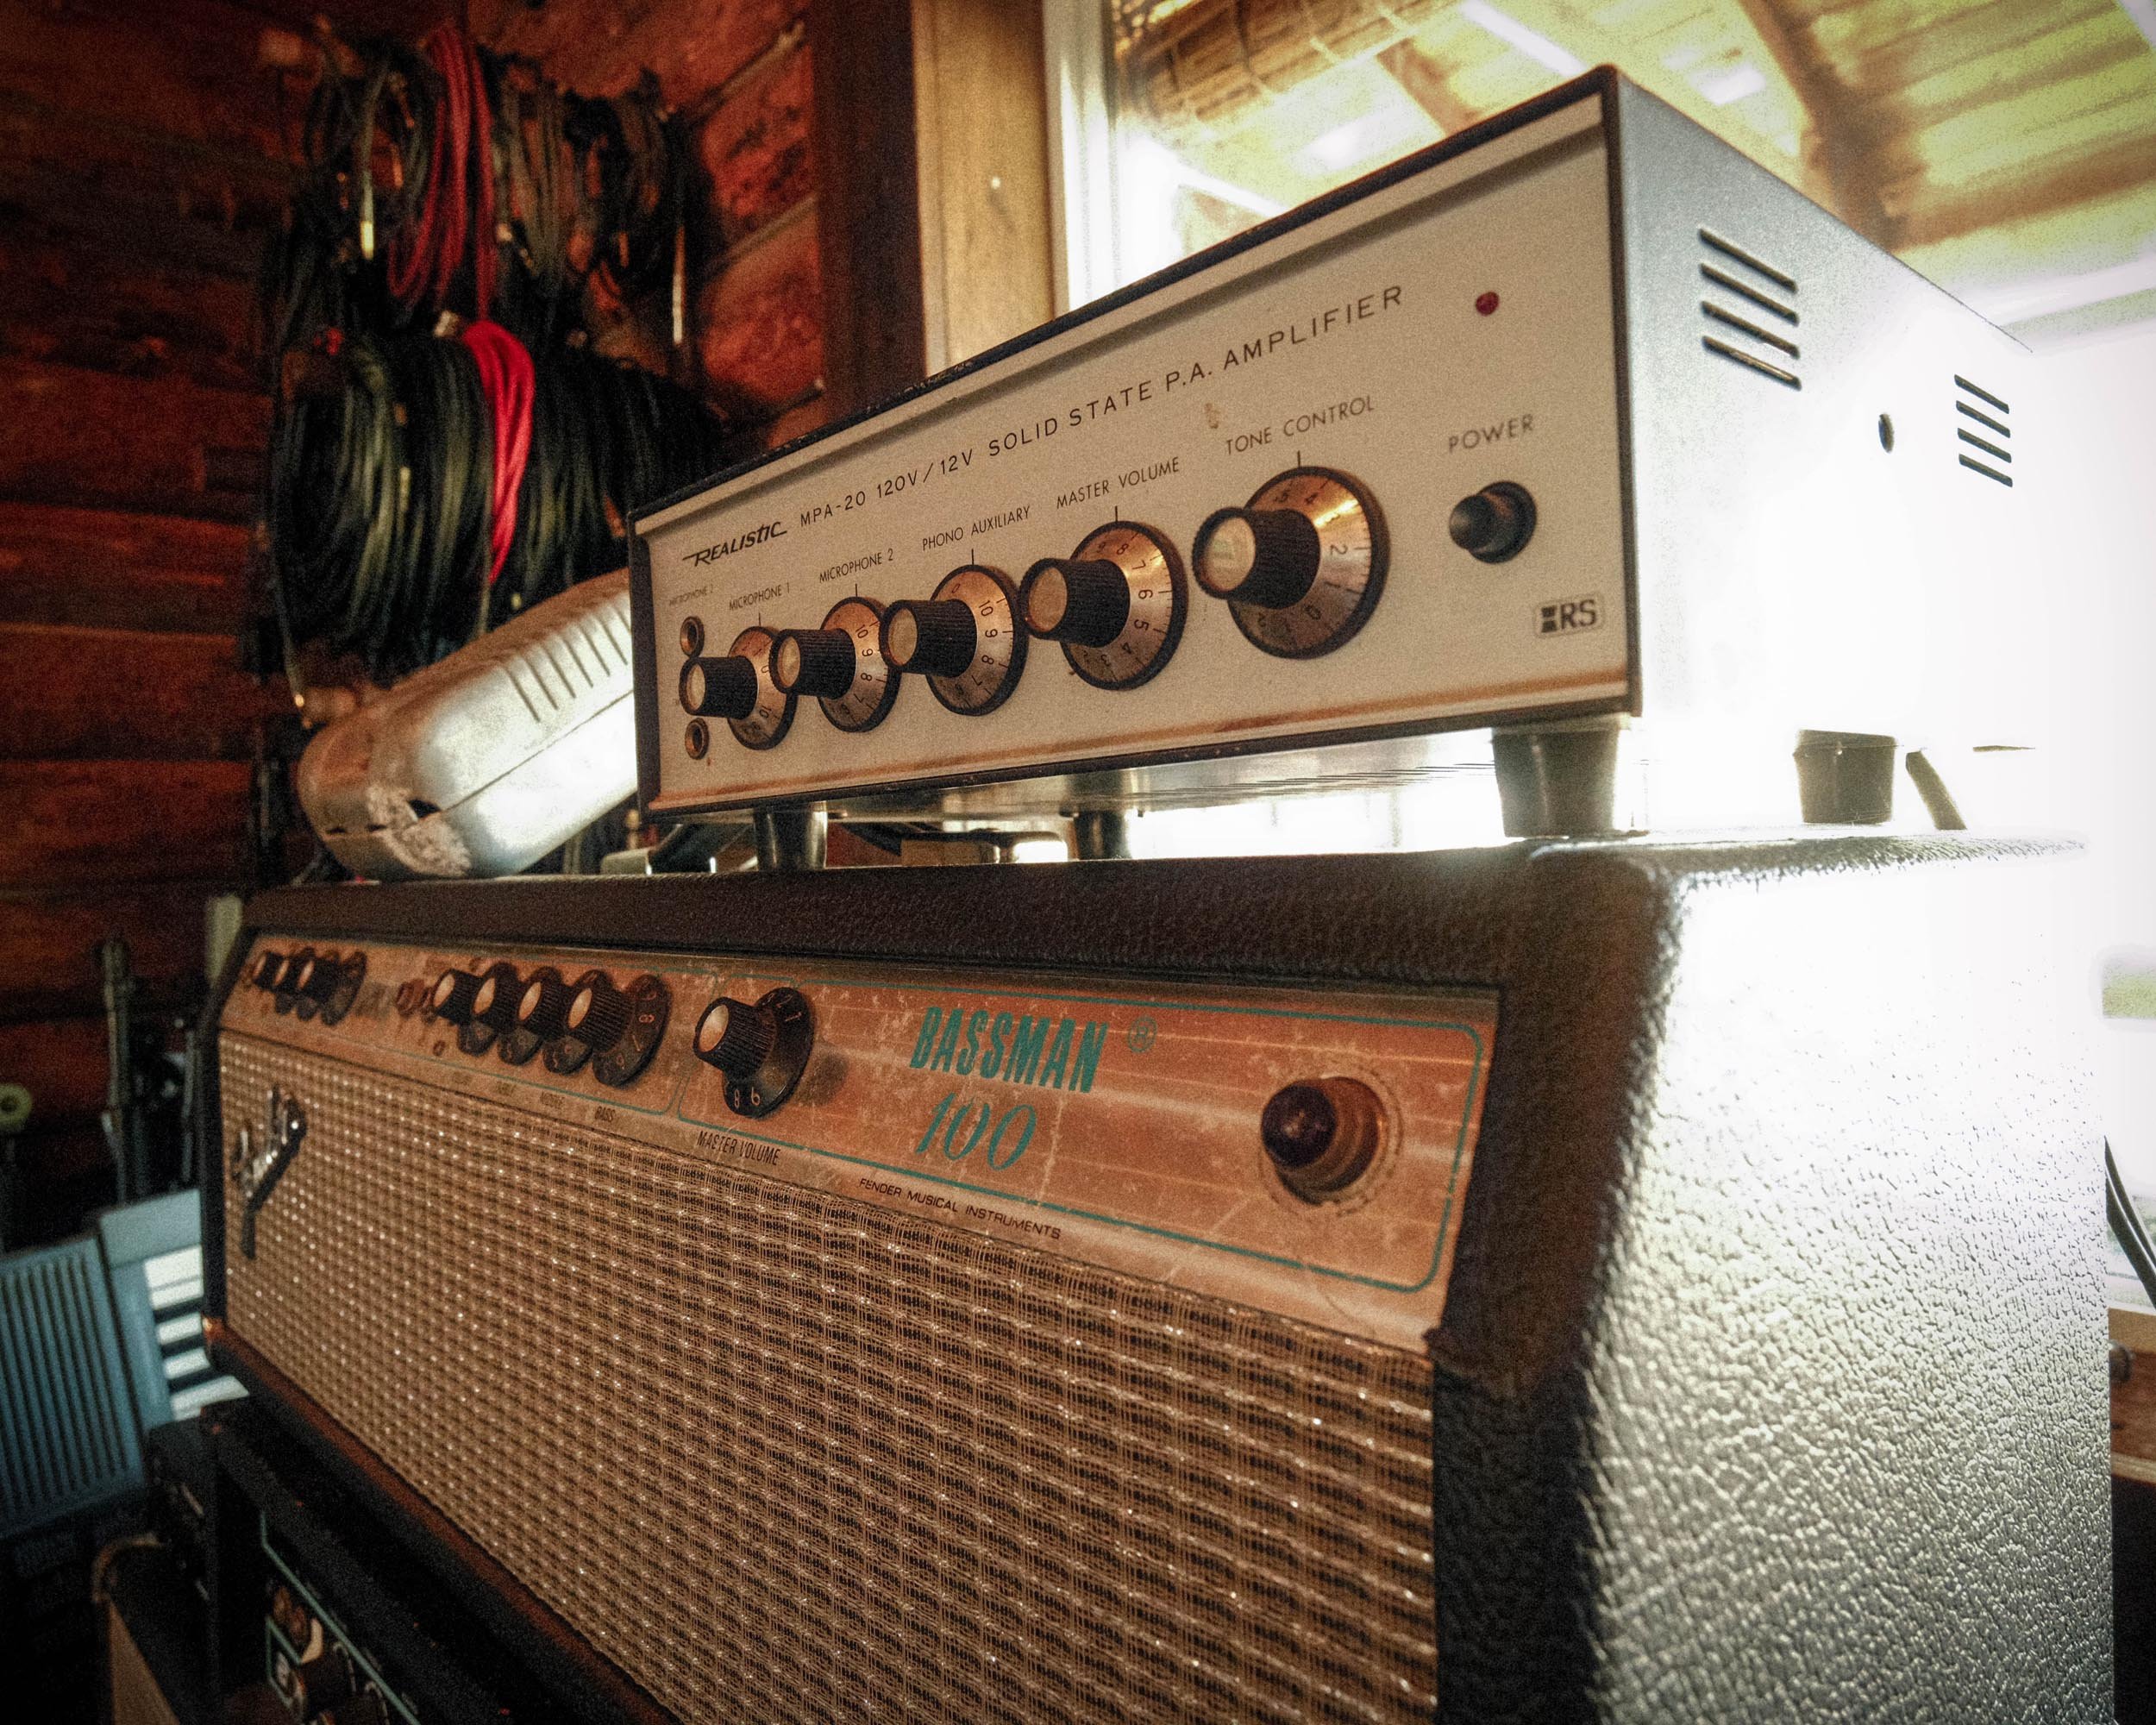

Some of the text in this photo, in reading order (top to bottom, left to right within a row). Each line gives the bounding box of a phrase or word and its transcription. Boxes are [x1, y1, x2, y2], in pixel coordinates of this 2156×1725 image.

[800, 491, 866, 527] MPA-20
[988, 417, 1058, 457] SOLID
[1069, 380, 1152, 427] STATE
[1166, 363, 1213, 392] P.A.
[1224, 285, 1402, 369] AMPLIFIER
[1225, 395, 1375, 455] TONE CONTROL
[1449, 414, 1534, 454] POWER
[1056, 457, 1180, 509] MASTER VOLUME
[923, 505, 1031, 551] PHONO AUXILIARY
[1116, 543, 1129, 556] 8
[1330, 543, 1347, 555] 2
[819, 549, 894, 583] MICROPHONE 2
[1131, 560, 1146, 570] 7
[730, 585, 782, 611] MICROPHONE
[1138, 589, 1153, 599] 6
[979, 600, 993, 617] 10
[856, 624, 869, 638] 10
[985, 629, 998, 638] 9
[1133, 618, 1150, 631] 5
[862, 648, 874, 658] 9
[981, 655, 994, 665] 8
[860, 672, 873, 682] 8
[910, 1007, 1108, 1093] BASSMAN
[734, 1088, 740, 1109] 8
[915, 1092, 1036, 1171] 100
[697, 1131, 780, 1165] MASTER VOLUME
[860, 1178, 1062, 1240] FENDER MUSICAL INSTRUMENTS
